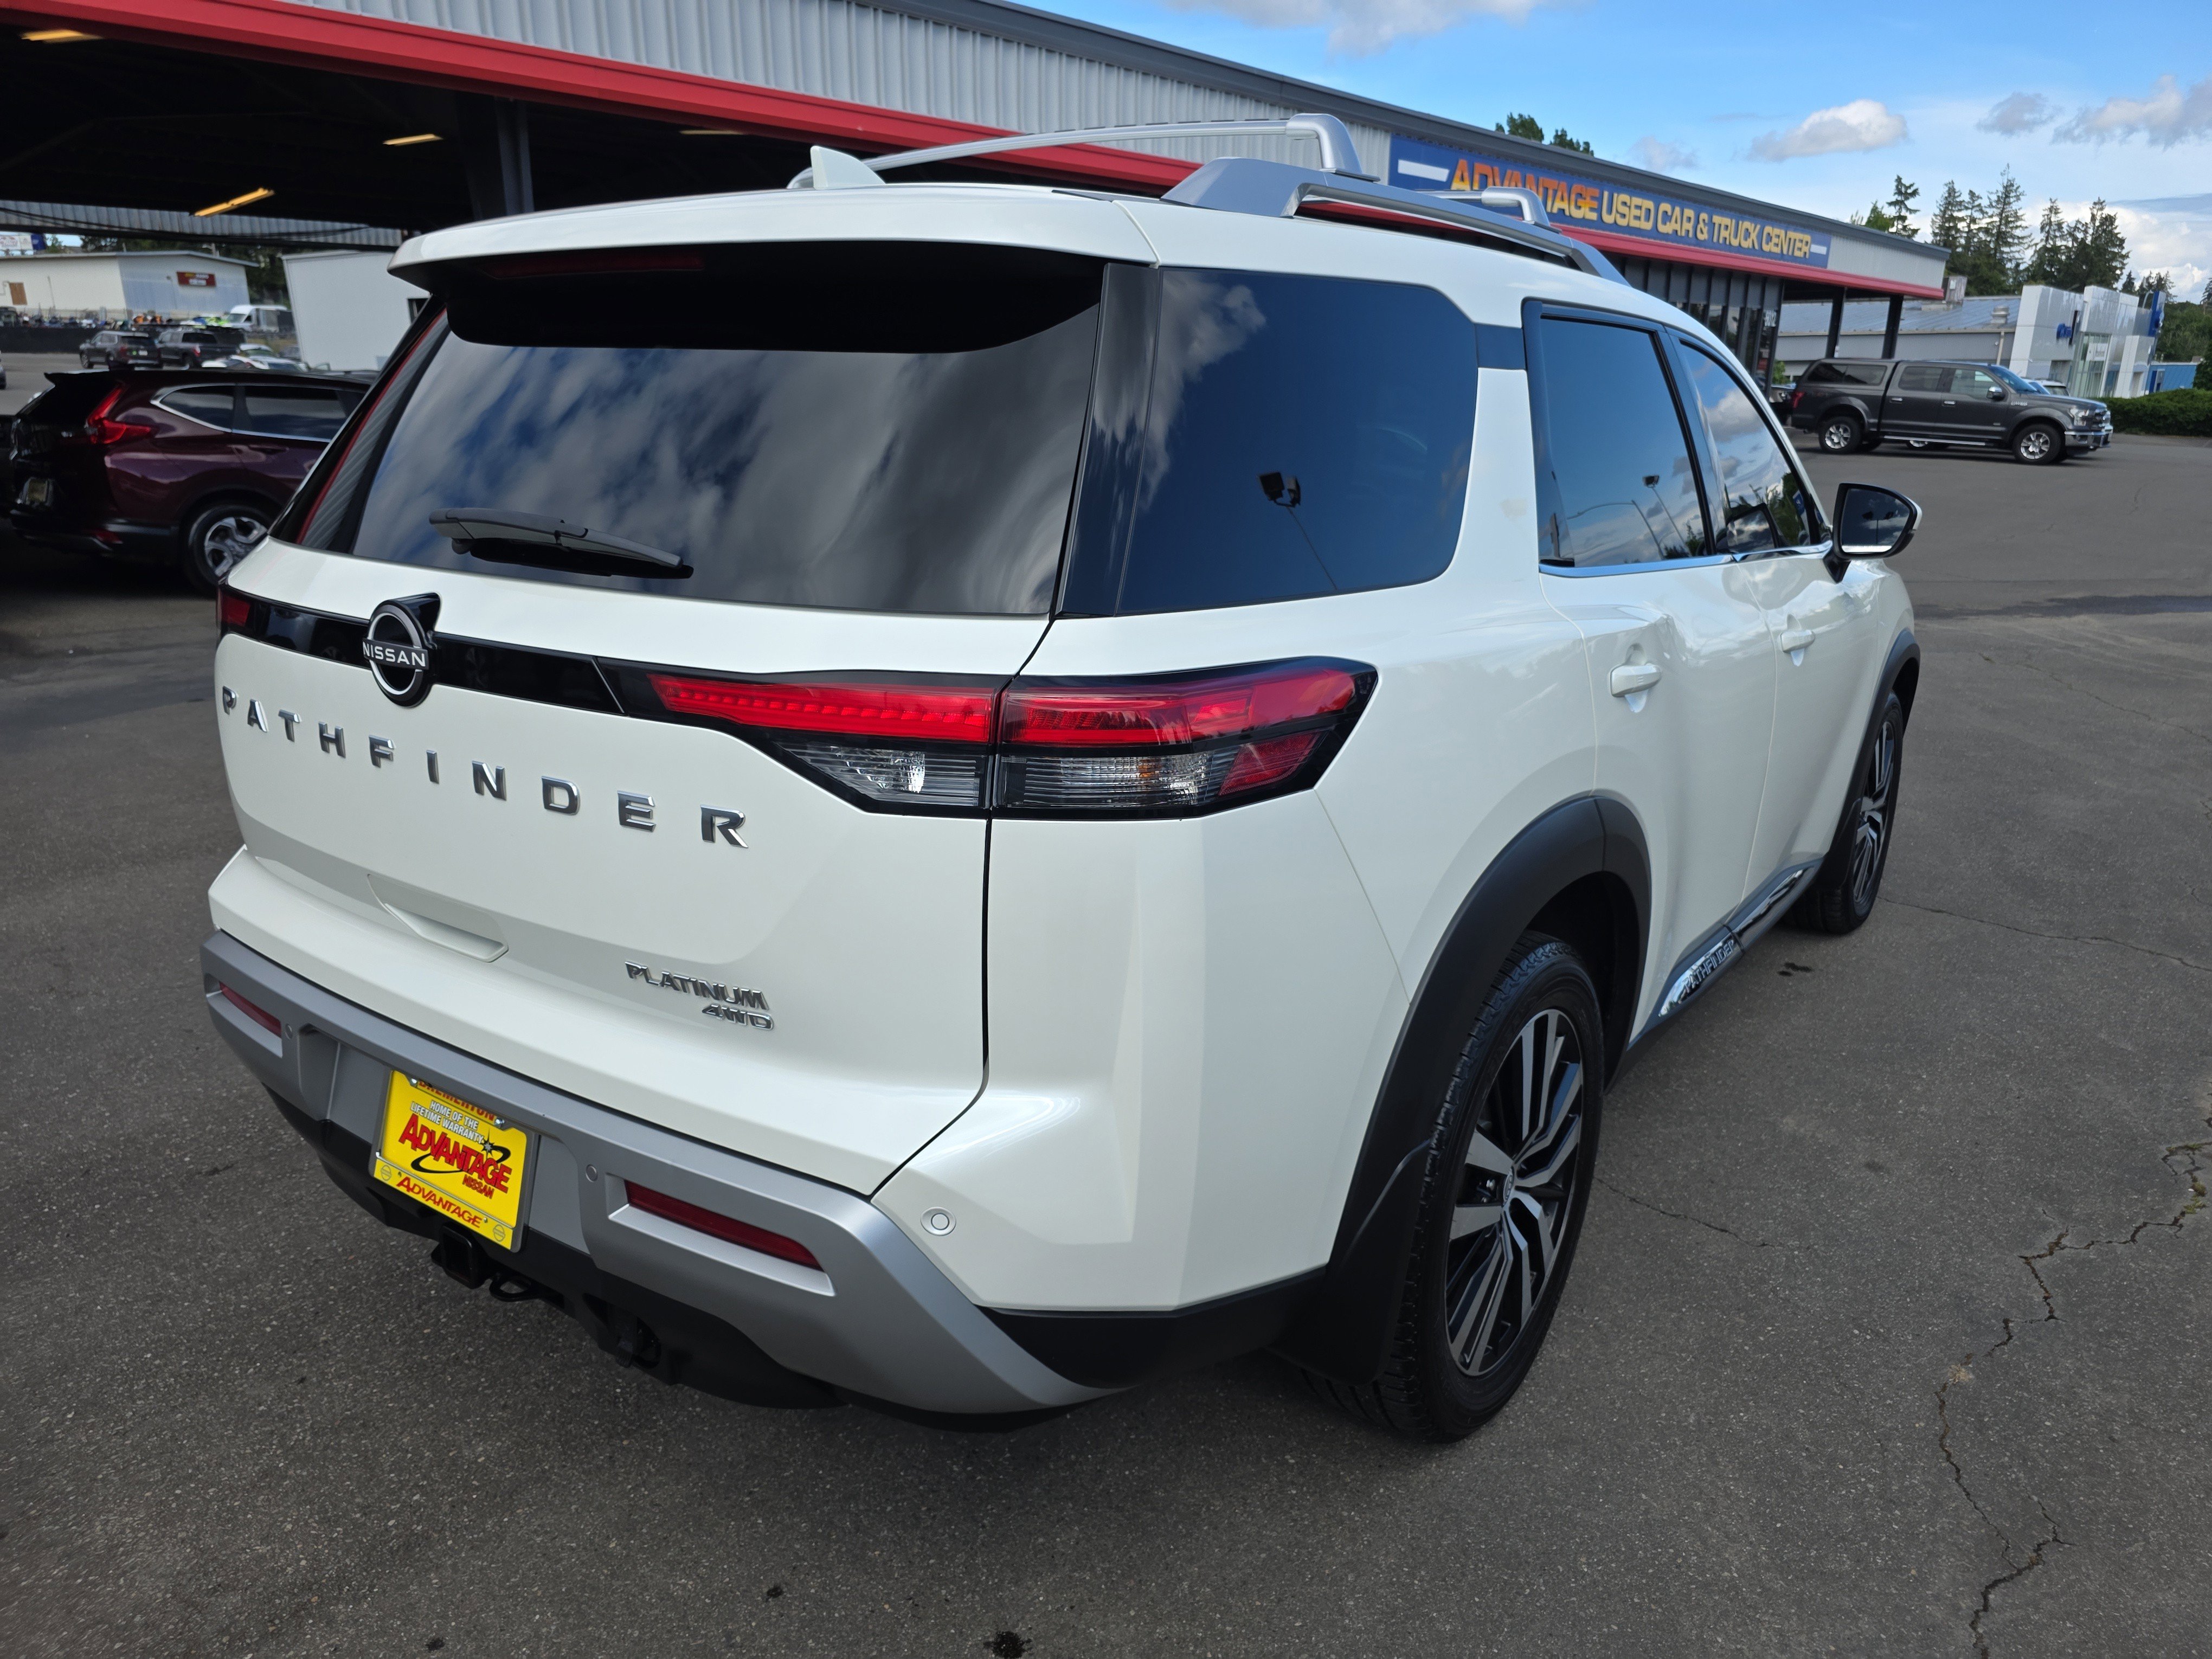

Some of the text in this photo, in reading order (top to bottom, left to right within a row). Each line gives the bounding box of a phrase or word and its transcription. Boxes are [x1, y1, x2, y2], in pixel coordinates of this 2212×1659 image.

[1602, 191, 1654, 230] USED
[1657, 202, 1694, 238] CAR
[1696, 213, 1708, 240] &
[1712, 215, 1760, 249] TRUCK
[1762, 225, 1811, 259] CENTER
[362, 641, 426, 667] NISSAN
[222, 686, 748, 848] PATHFINDER
[625, 961, 769, 1011] PLATINUM
[1682, 940, 1734, 993] PATHFINDER
[702, 1004, 774, 1031] 4WD
[410, 1101, 442, 1125] LIFETIME
[442, 1118, 484, 1144] WARRANTY
[430, 1099, 479, 1130] HOME OF THE
[398, 1113, 512, 1194] ADVANTAGE
[396, 1176, 483, 1228] ADVANTAGE
[462, 1174, 494, 1199] NISSAN
